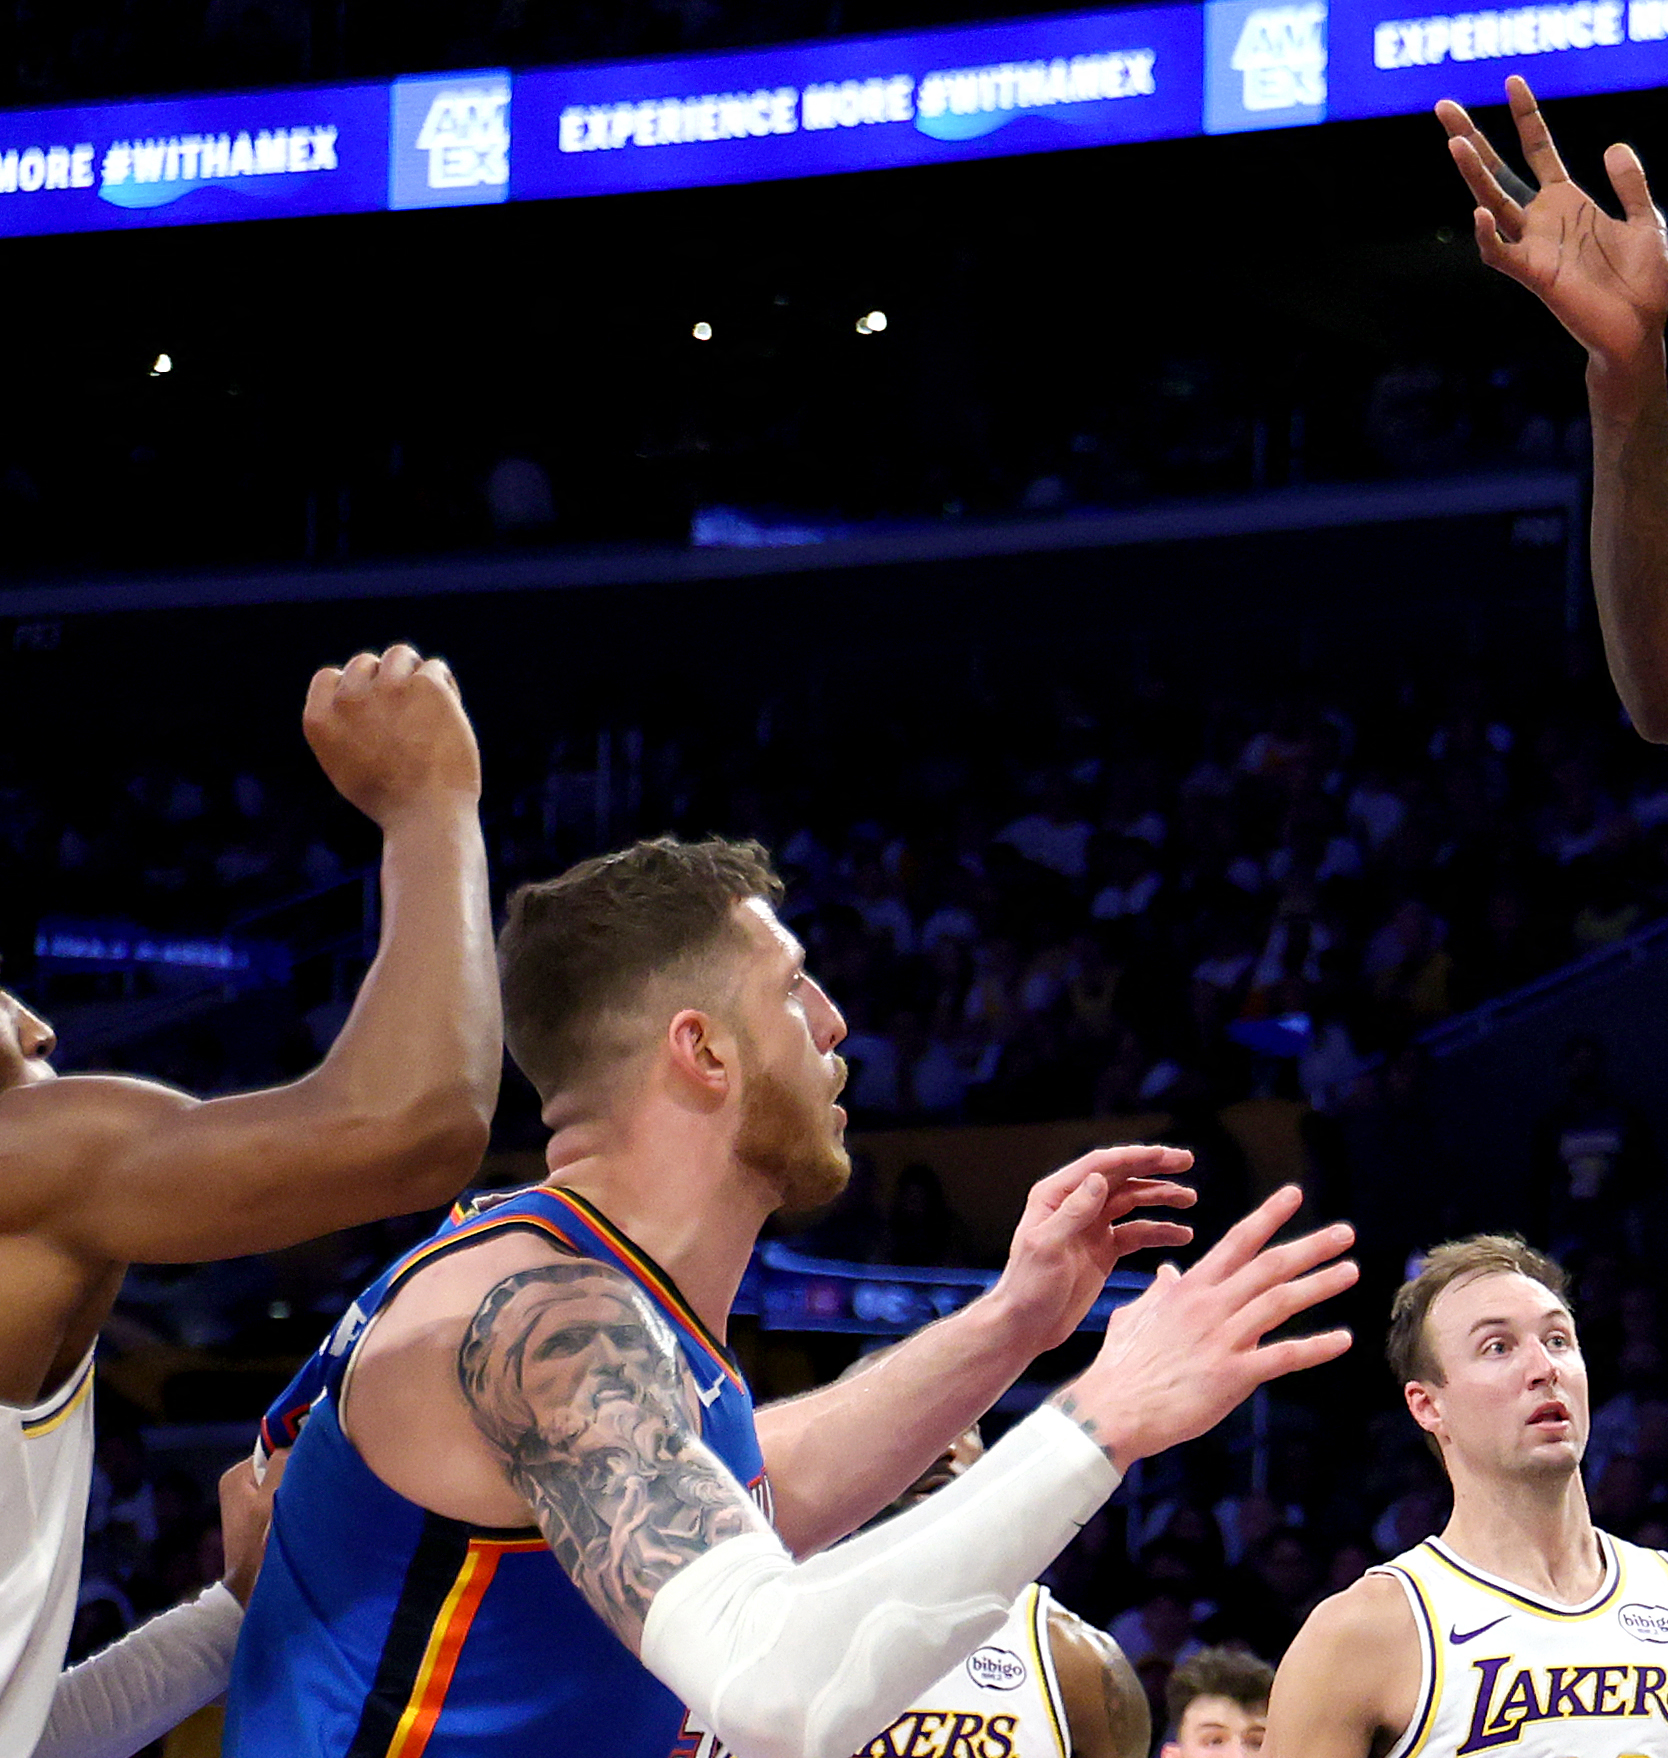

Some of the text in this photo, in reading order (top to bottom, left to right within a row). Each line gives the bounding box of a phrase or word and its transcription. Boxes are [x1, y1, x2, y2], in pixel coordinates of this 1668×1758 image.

[1373, 0, 1625, 70] EXPERIENCE
[559, 47, 1155, 152] EXPERIENCE MORE #WITHAMEX
[101, 124, 338, 185] #WITHAMEX
[973, 1656, 1023, 1679] bibigo
